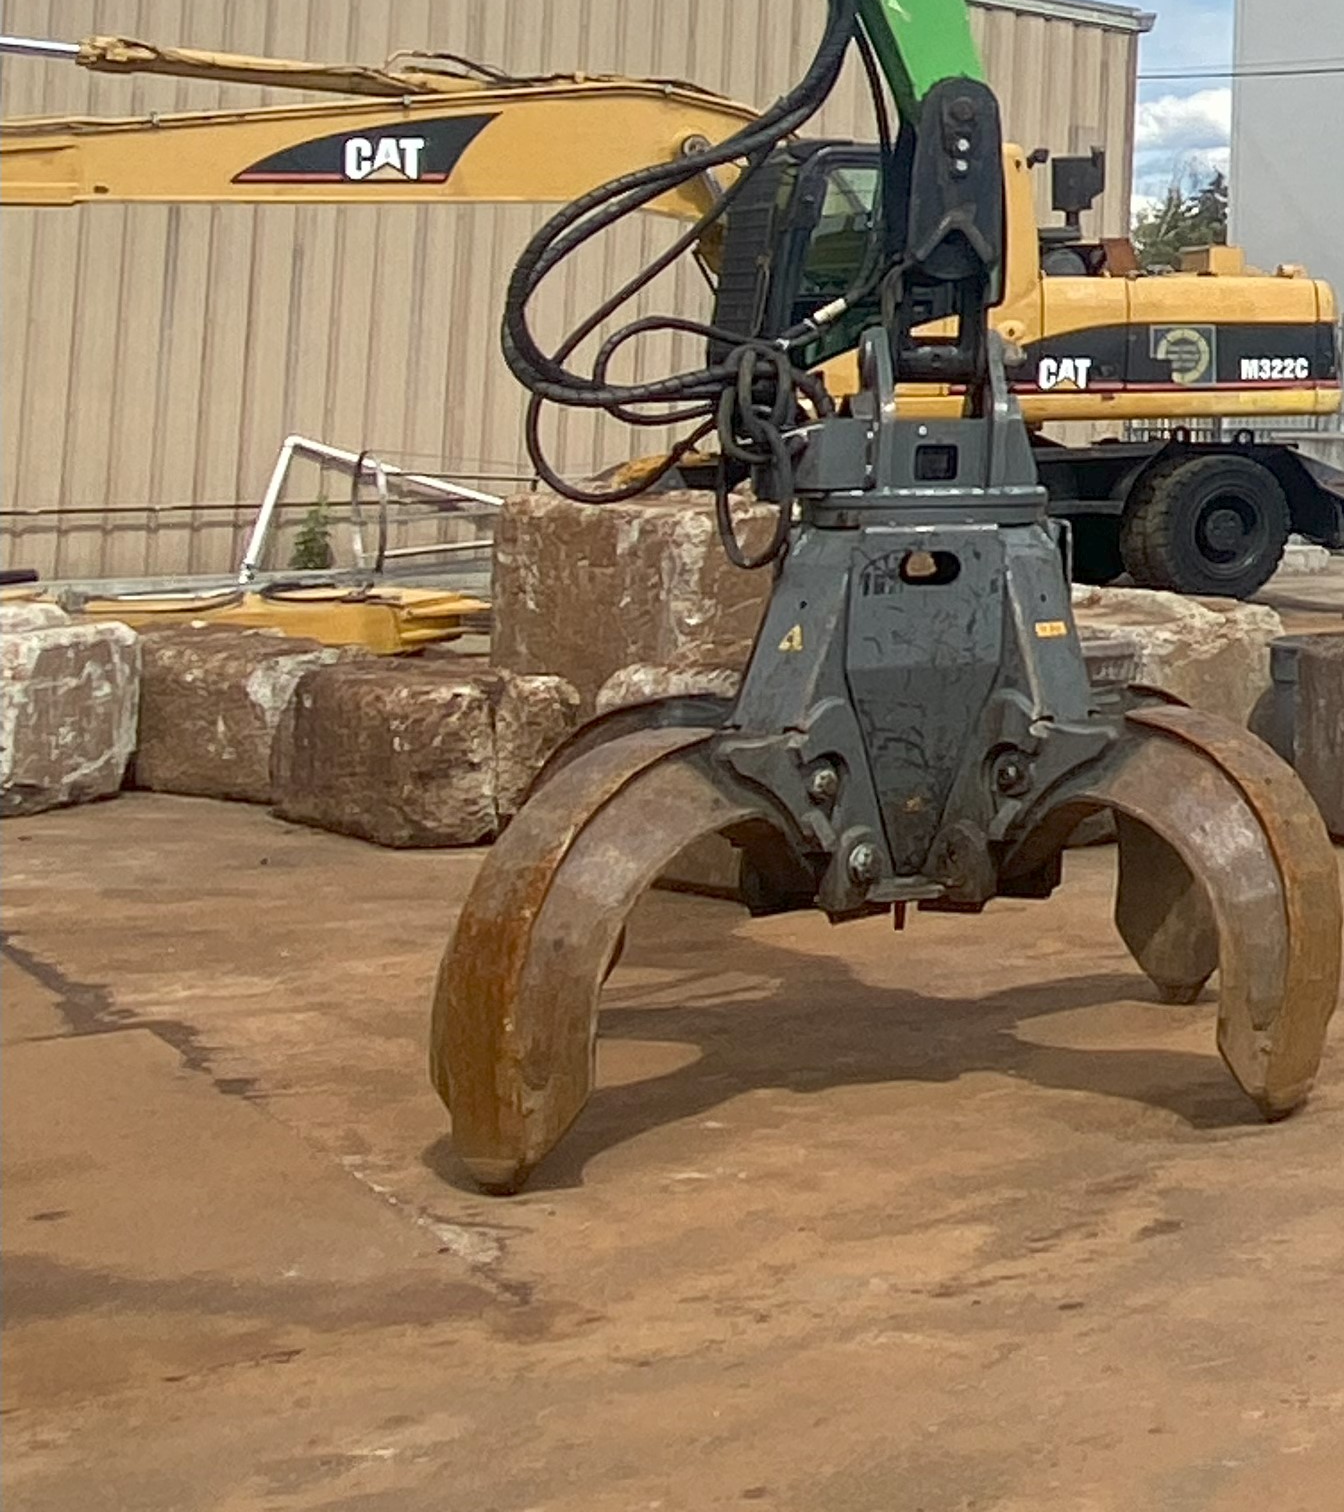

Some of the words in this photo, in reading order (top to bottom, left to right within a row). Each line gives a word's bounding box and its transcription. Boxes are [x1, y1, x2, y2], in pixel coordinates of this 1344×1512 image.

[344, 137, 425, 180] CAT
[1038, 358, 1091, 389] CAT
[1240, 358, 1309, 380] M322C
